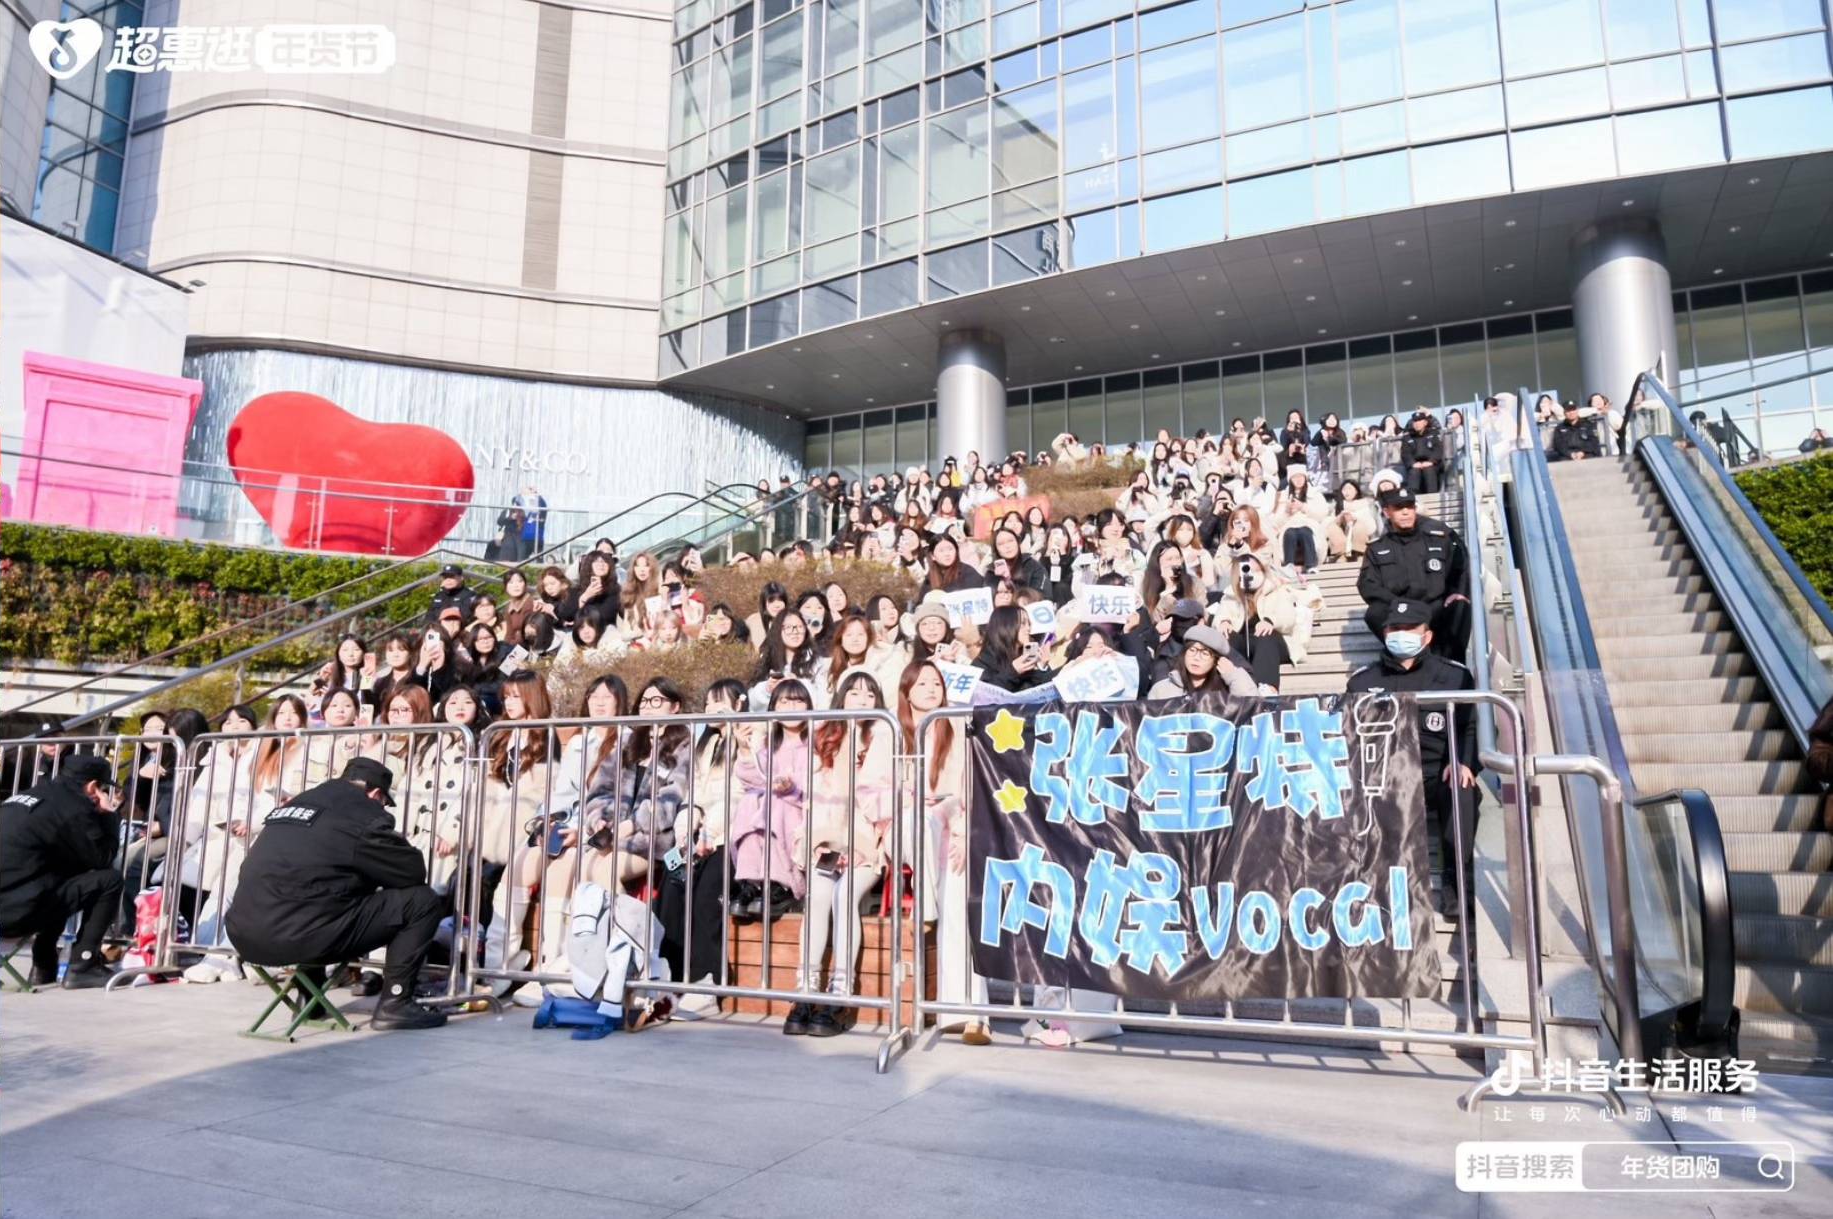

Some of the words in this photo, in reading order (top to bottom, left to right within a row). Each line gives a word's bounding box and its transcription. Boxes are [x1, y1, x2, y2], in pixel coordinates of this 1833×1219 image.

[1089, 594, 1131, 615] 快乐
[1030, 698, 1353, 833] 张星特
